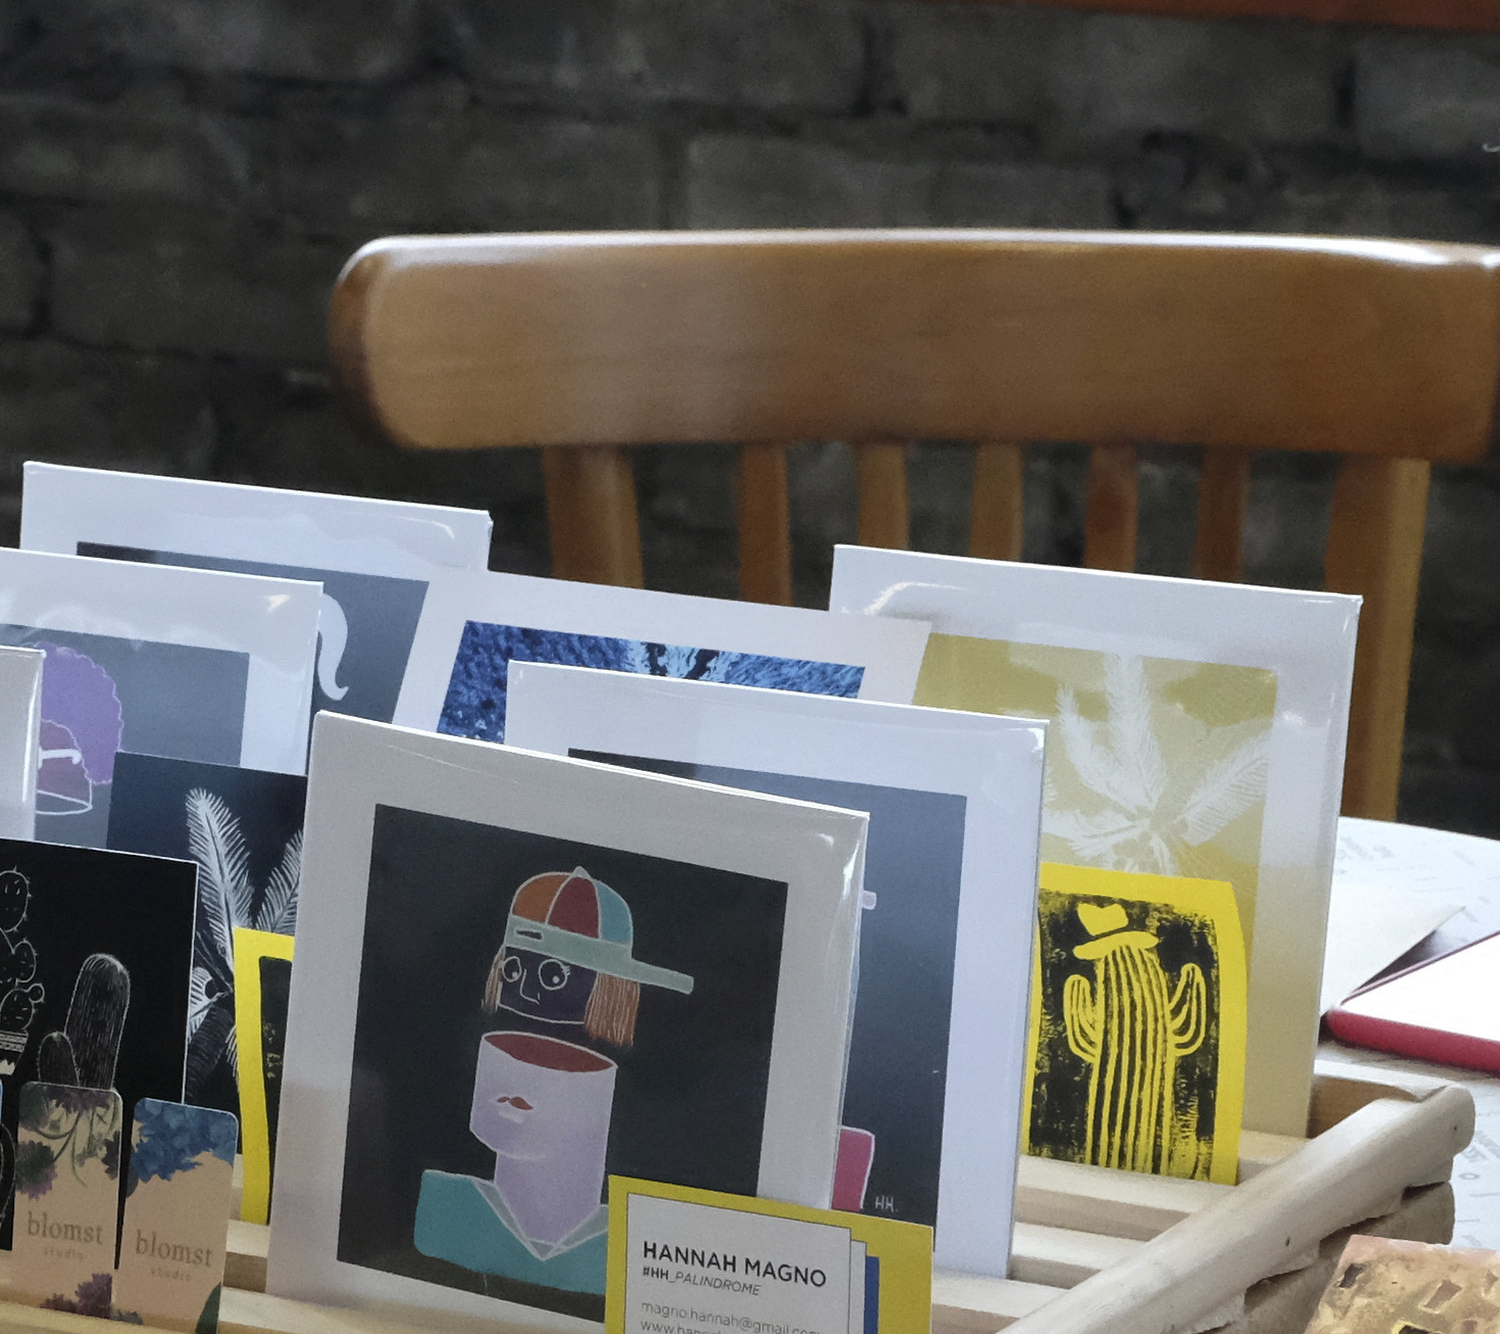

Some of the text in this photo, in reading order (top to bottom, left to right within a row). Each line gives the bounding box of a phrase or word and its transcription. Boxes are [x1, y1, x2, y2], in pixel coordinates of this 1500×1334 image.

[26, 1211, 103, 1247] blomst
[134, 1229, 214, 1268] blomst
[643, 1241, 827, 1288] HANNAH MAGNO
[642, 1266, 763, 1297] #HH_PALINDROME
